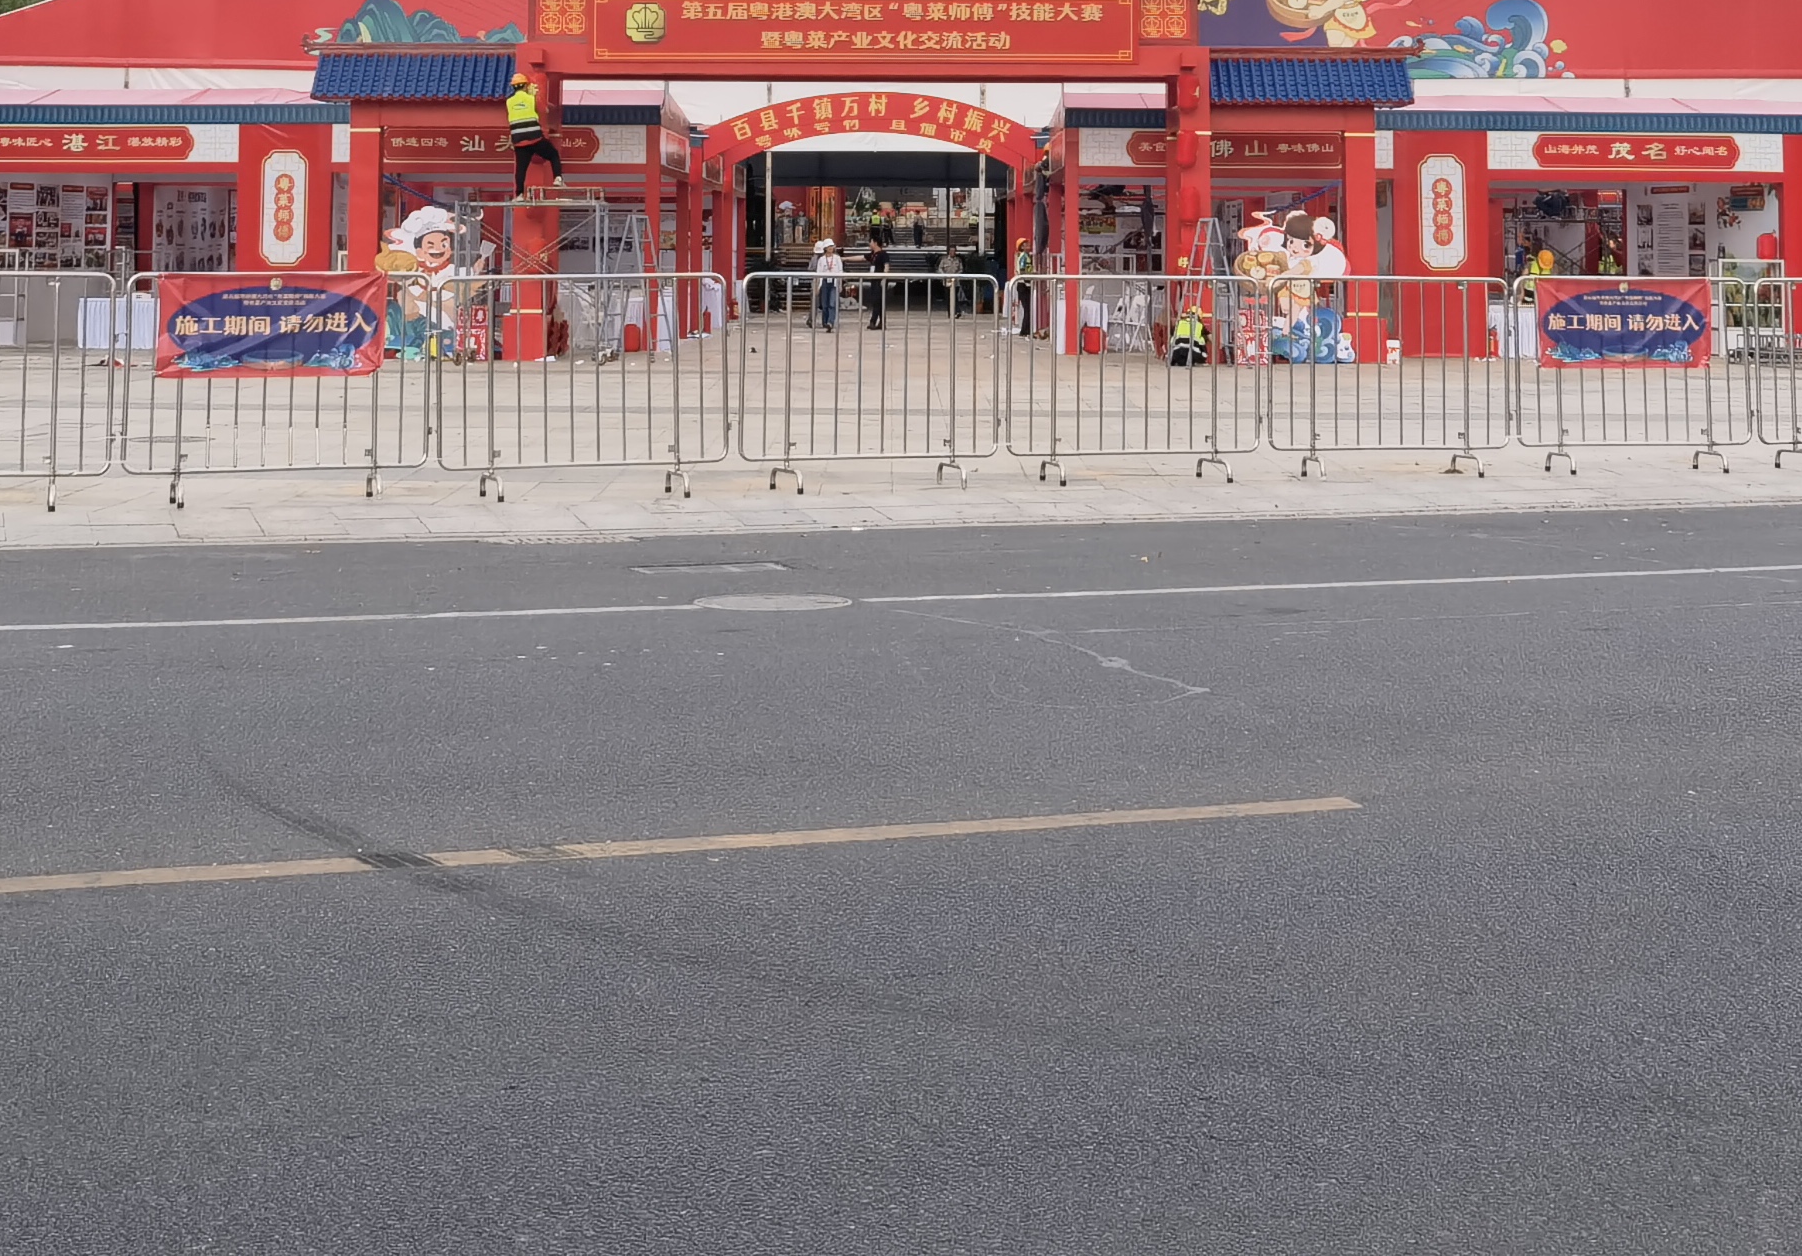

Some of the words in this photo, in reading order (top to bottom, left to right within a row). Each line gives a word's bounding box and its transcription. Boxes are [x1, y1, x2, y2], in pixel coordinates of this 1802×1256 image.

[681, 1, 1103, 22] 第五届粤港澳大湾区“粤菜师傅”技能大赛
[761, 31, 1011, 49] 暨粤菜产业文化交流活动
[730, 94, 887, 140] 百县千镇万村
[910, 97, 1010, 142] 乡村振兴
[61, 133, 121, 152] 湛江
[460, 135, 514, 152] 汕头
[1210, 139, 1268, 158] 佛山
[1608, 142, 1667, 161] 茂名
[174, 315, 271, 336] 施工期间
[278, 312, 373, 334] 请勿进入
[1548, 313, 1621, 331] 施工期间
[1627, 313, 1700, 331] 请勿进入
